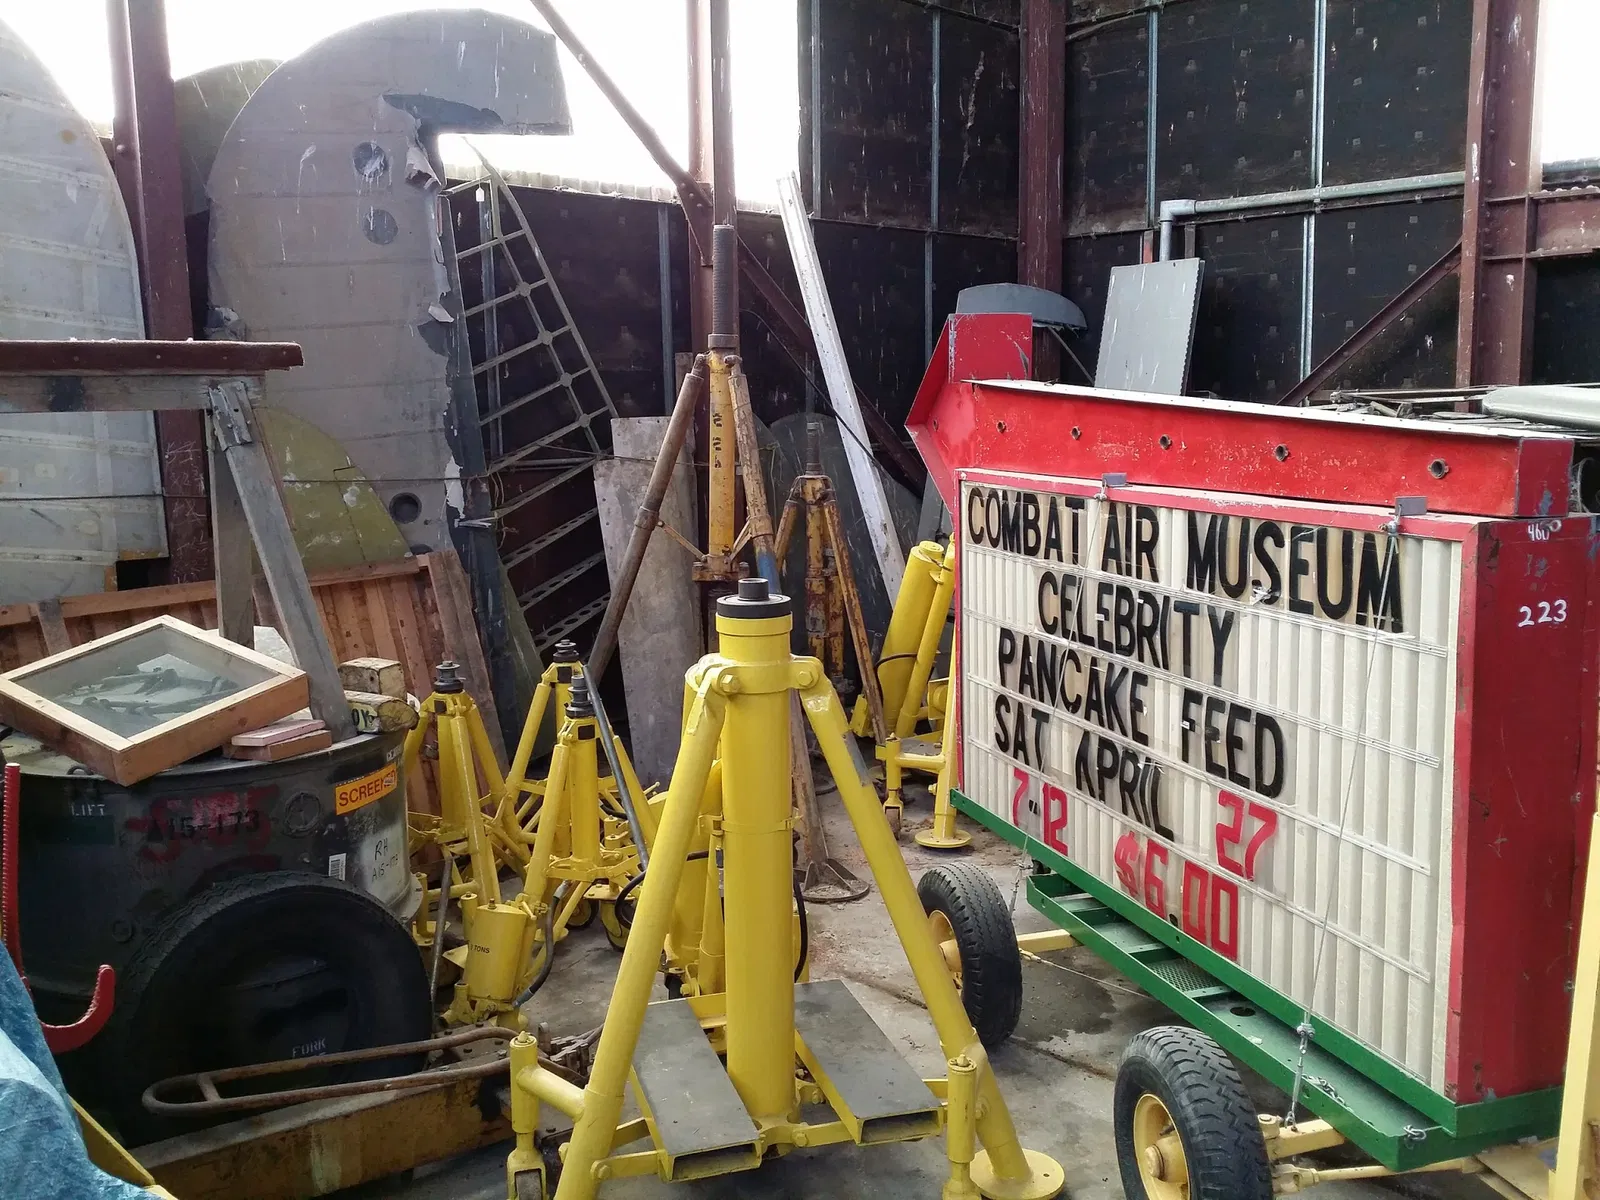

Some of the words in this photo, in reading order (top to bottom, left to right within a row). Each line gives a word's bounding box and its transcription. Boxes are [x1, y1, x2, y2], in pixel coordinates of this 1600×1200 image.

[968, 487, 1085, 566] COMBAT
[1101, 503, 1160, 583] AIR
[1186, 510, 1405, 634] MUSEUM
[1518, 599, 1567, 627] 223
[1038, 571, 1235, 688] CELEBRITY
[998, 628, 1148, 746] PANCAKE
[1181, 687, 1285, 799] FEED
[71, 803, 106, 818] LIFT
[374, 838, 388, 861] RH
[994, 694, 1049, 775] SAT
[1075, 730, 1174, 842] APRIL
[1215, 789, 1277, 882] 27
[1114, 831, 1238, 962] $6.00
